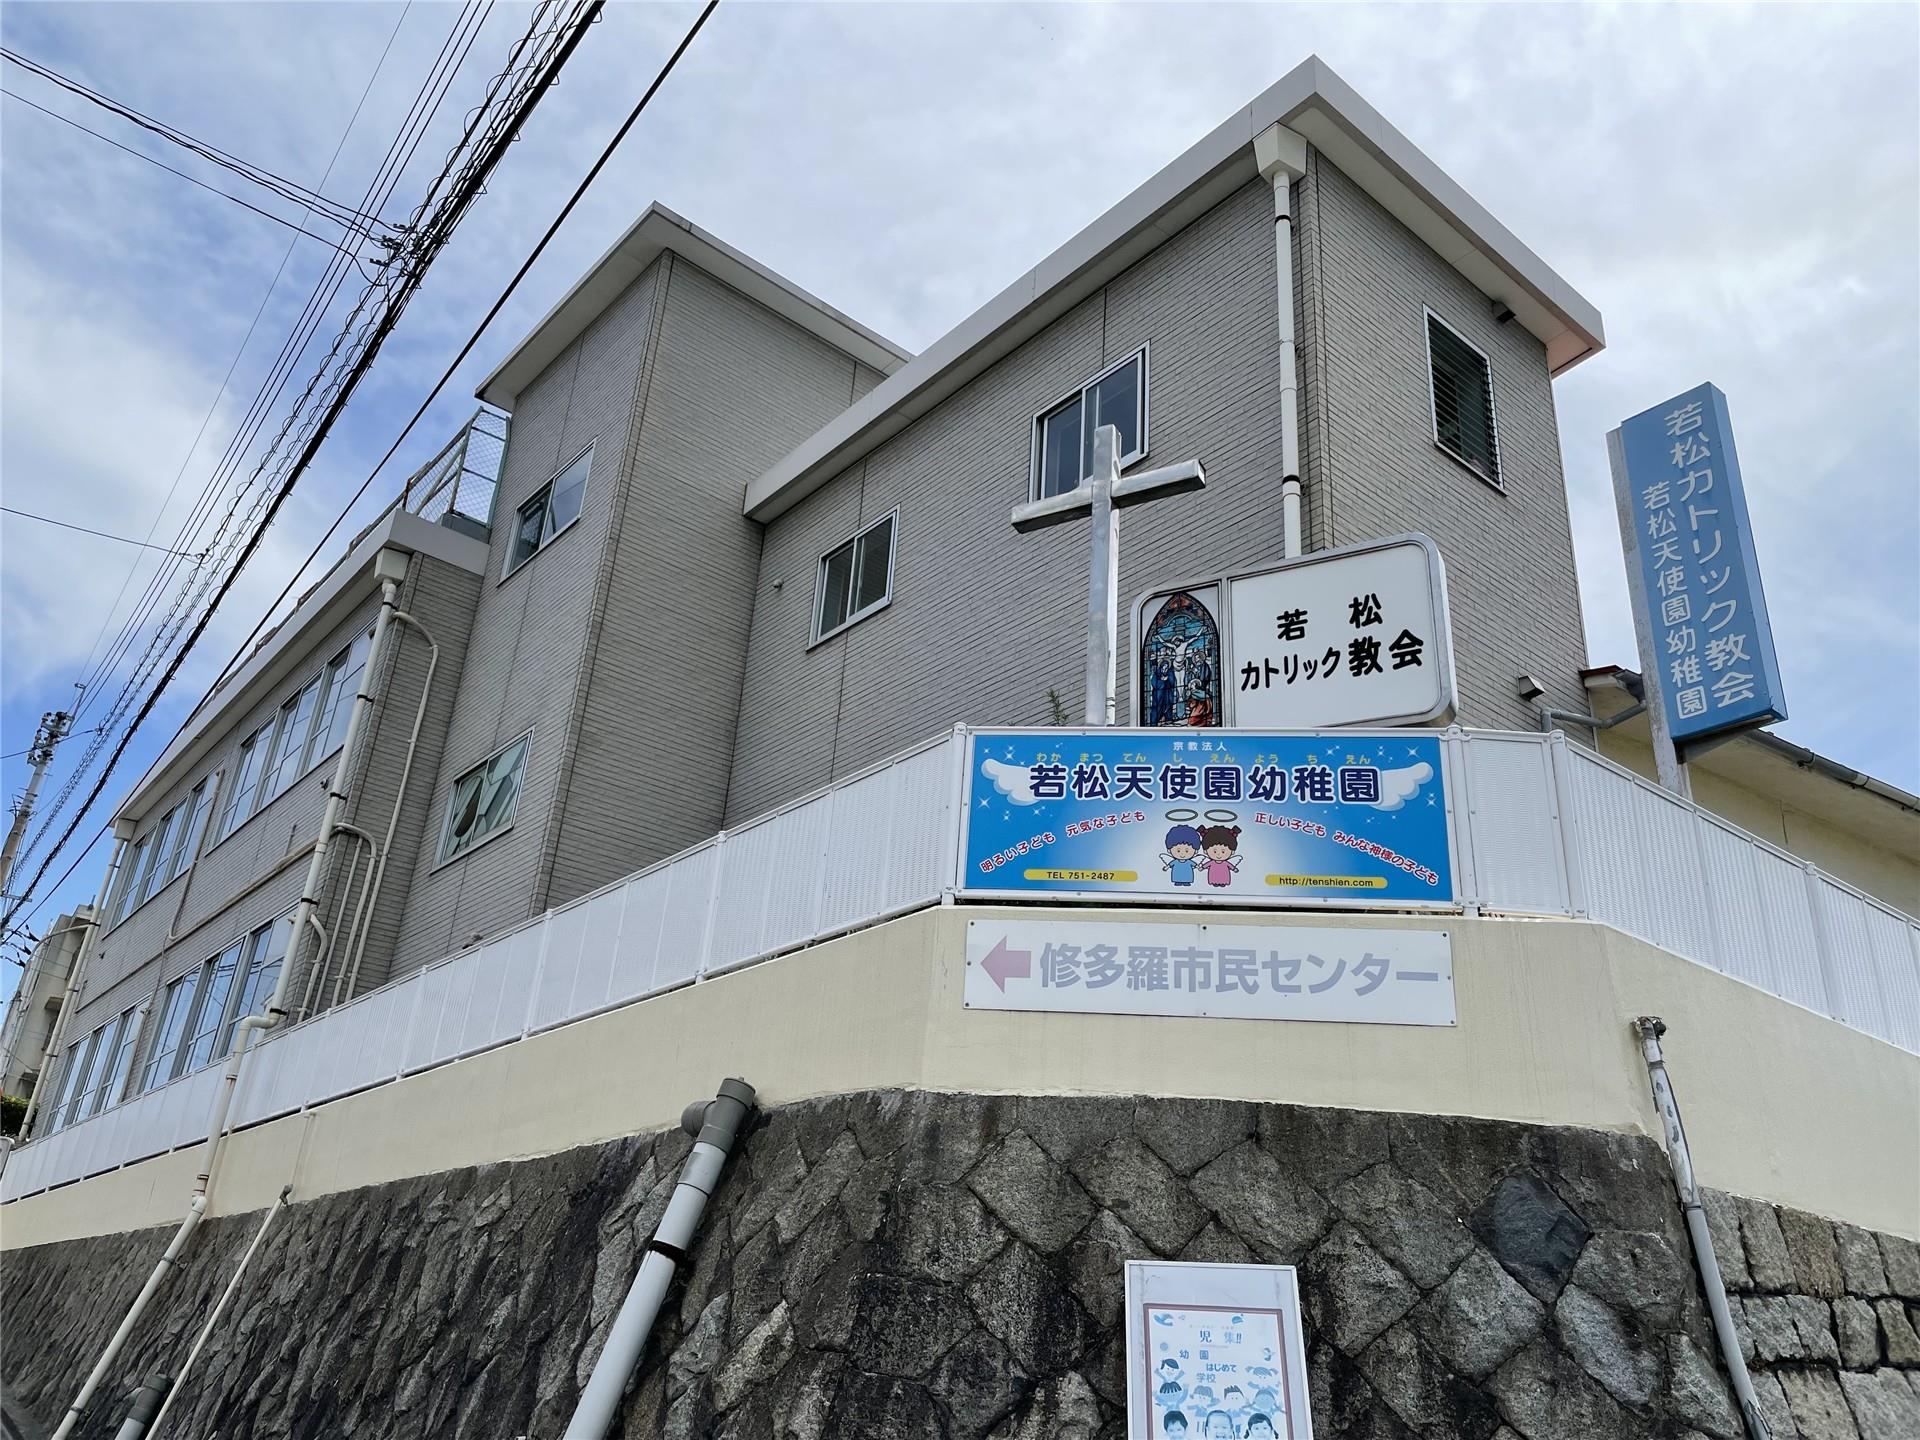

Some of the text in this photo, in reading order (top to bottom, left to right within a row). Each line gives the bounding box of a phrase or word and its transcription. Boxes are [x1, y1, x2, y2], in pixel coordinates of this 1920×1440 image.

[1663, 400, 1755, 709] 若松カトリック教会
[1276, 593, 1384, 641] 若松
[1641, 480, 1708, 720] 若松天使園幼稚園
[1240, 628, 1424, 692] カトリック教会
[1173, 741, 1227, 751] 宗教法人
[1028, 764, 1380, 802] 若松天使園幼稚園
[981, 811, 1146, 872] 明るい子ども 元気な子ども
[1255, 812, 1438, 885] 正しい子ども みんな神様の子ども
[1047, 871, 1115, 880] TEL 751-2487
[1279, 876, 1373, 887] http://tenshien.com
[1039, 942, 1439, 997] 修多羅市民センター
